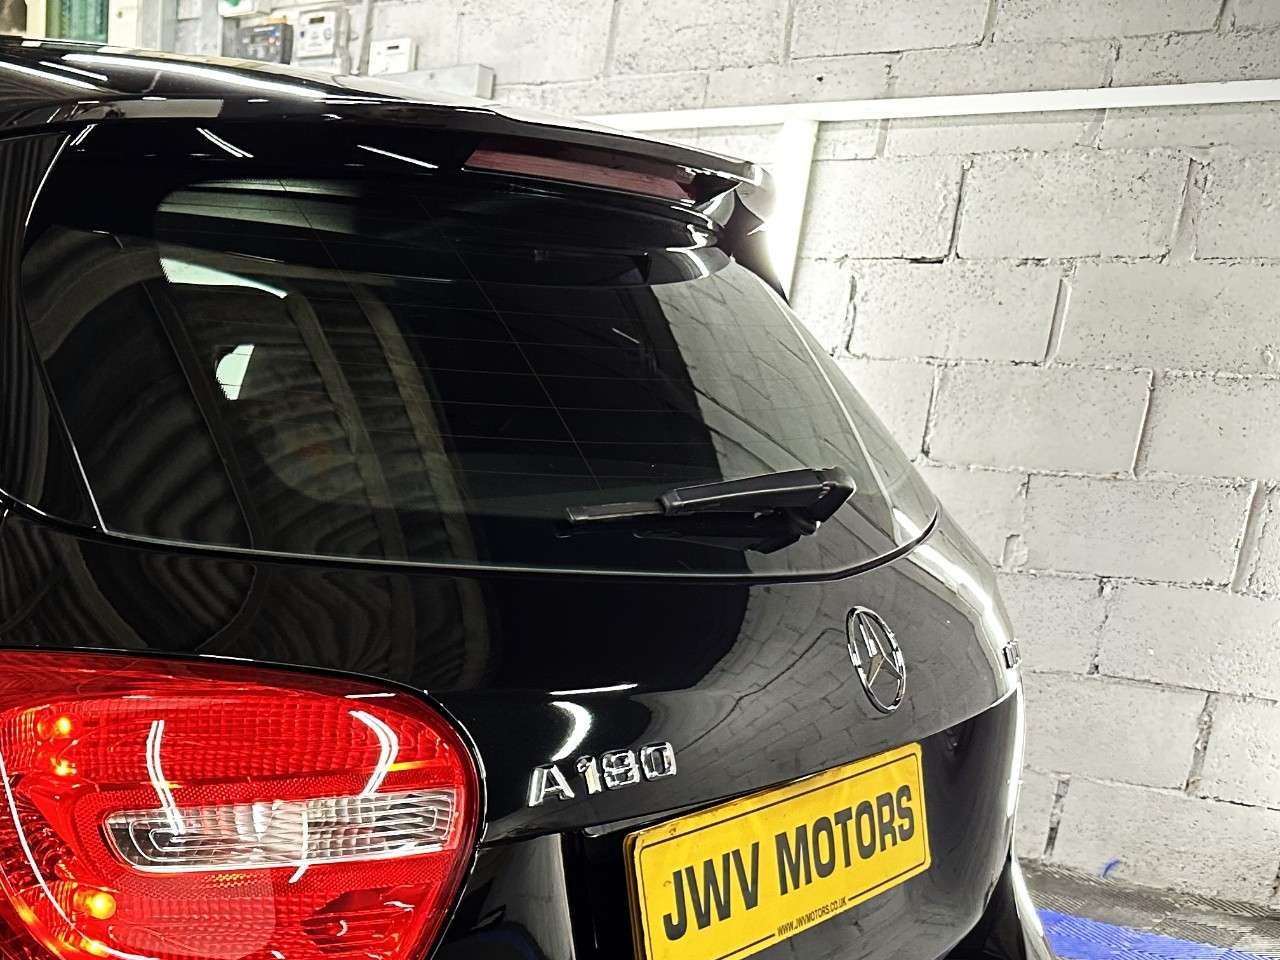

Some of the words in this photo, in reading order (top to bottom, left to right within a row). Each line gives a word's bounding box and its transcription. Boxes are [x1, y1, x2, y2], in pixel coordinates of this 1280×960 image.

[663, 841, 760, 941] JWV
[774, 784, 915, 896] MOTORS
[776, 896, 847, 937] WWW.JWVMOTORS.CO.UK
